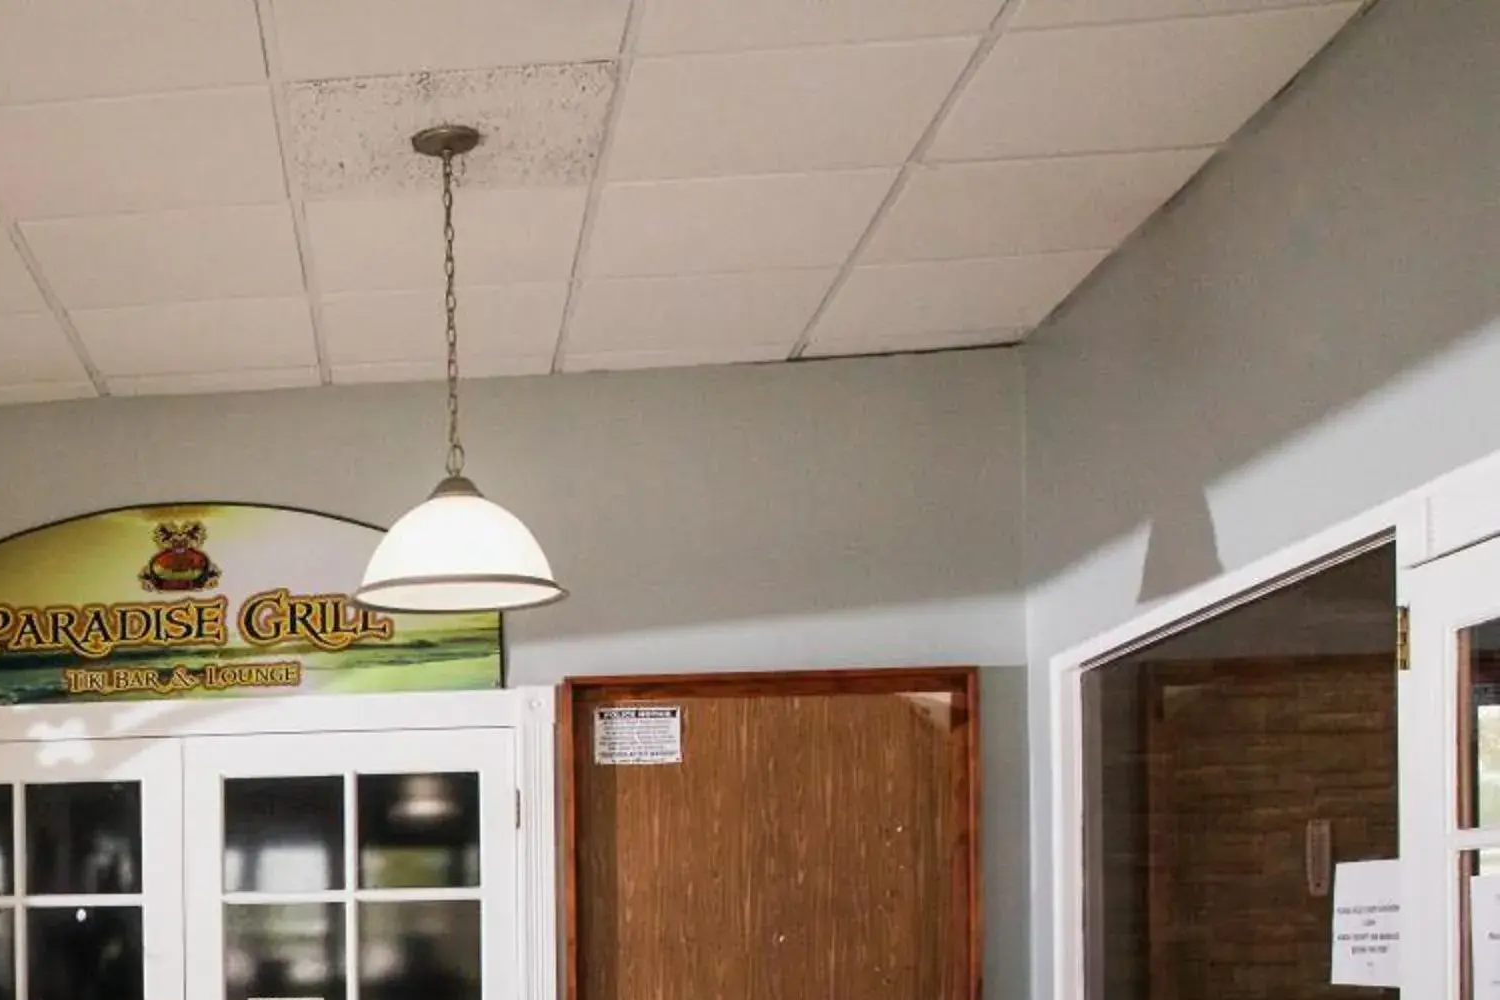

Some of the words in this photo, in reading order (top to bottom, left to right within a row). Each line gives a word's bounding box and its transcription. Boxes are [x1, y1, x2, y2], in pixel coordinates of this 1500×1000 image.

[240, 591, 390, 650] GRILL
[67, 669, 106, 691] TIKI
[114, 668, 159, 690] BAR
[171, 665, 197, 688] &
[206, 665, 297, 686] LOUNGE
